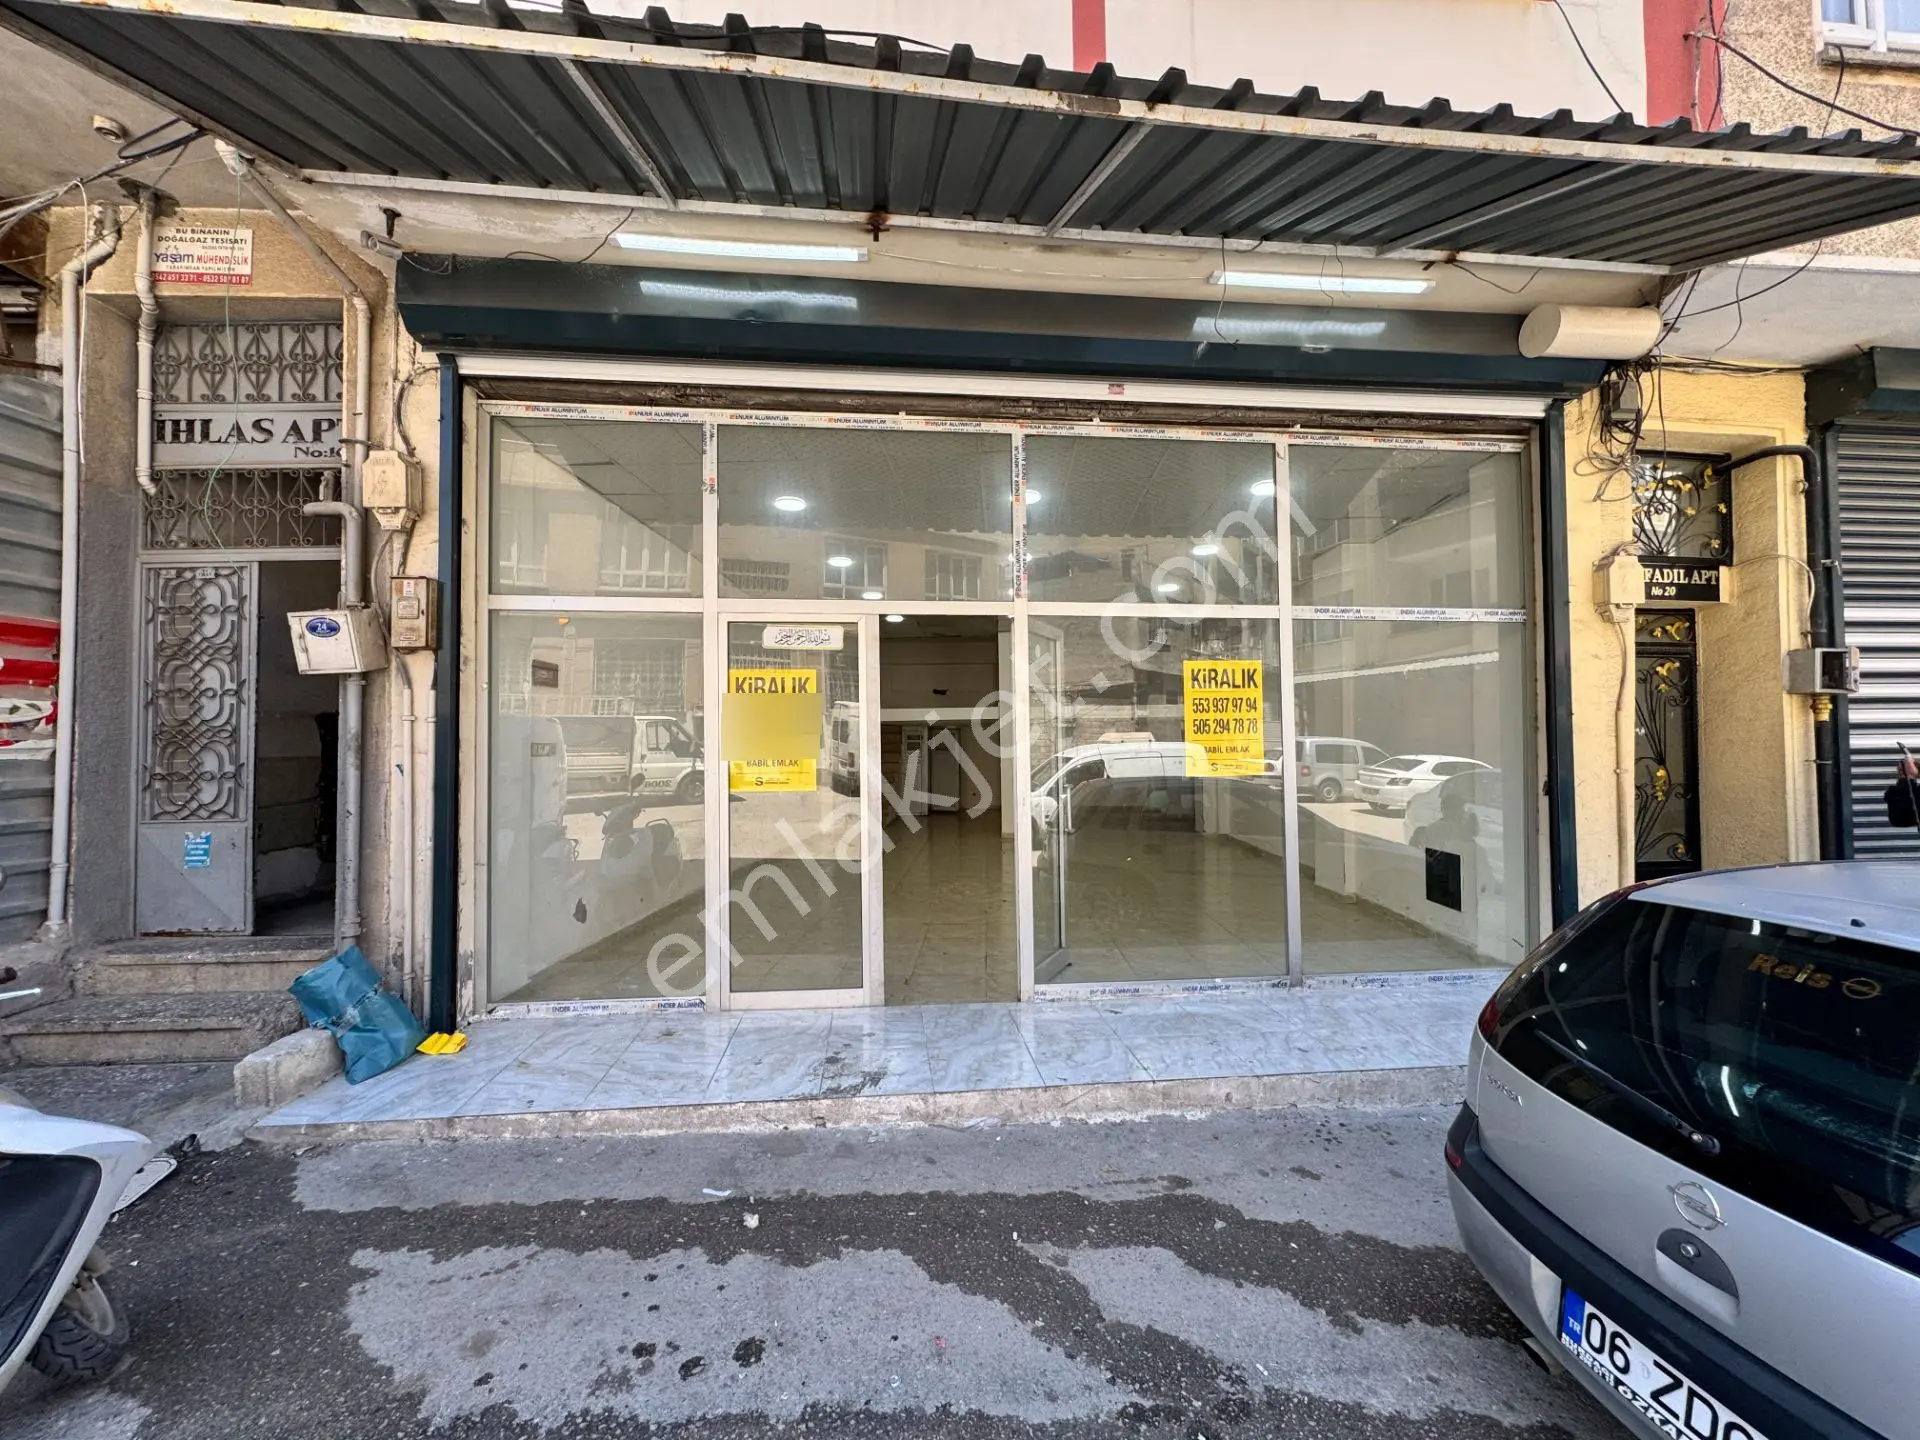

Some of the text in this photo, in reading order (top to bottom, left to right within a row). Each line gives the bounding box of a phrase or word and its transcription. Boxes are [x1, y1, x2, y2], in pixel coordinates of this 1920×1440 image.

[281, 418, 342, 444] AP
[1643, 568, 1718, 584] FADIL APT
[1651, 586, 1676, 596] No 20
[1192, 697, 1258, 714] 553 937 97 94
[1193, 718, 1210, 734] 505
[1212, 718, 1230, 734] 294
[1233, 718, 1244, 734] 78
[1226, 745, 1250, 754] EMLAK
[772, 760, 799, 768] EMLAK
[754, 776, 764, 786] S
[1748, 953, 1832, 988] Reis
[1567, 1316, 1581, 1335] TR
[1585, 1312, 1631, 1375] 06
[1618, 1384, 1694, 1440] ÖZKA
